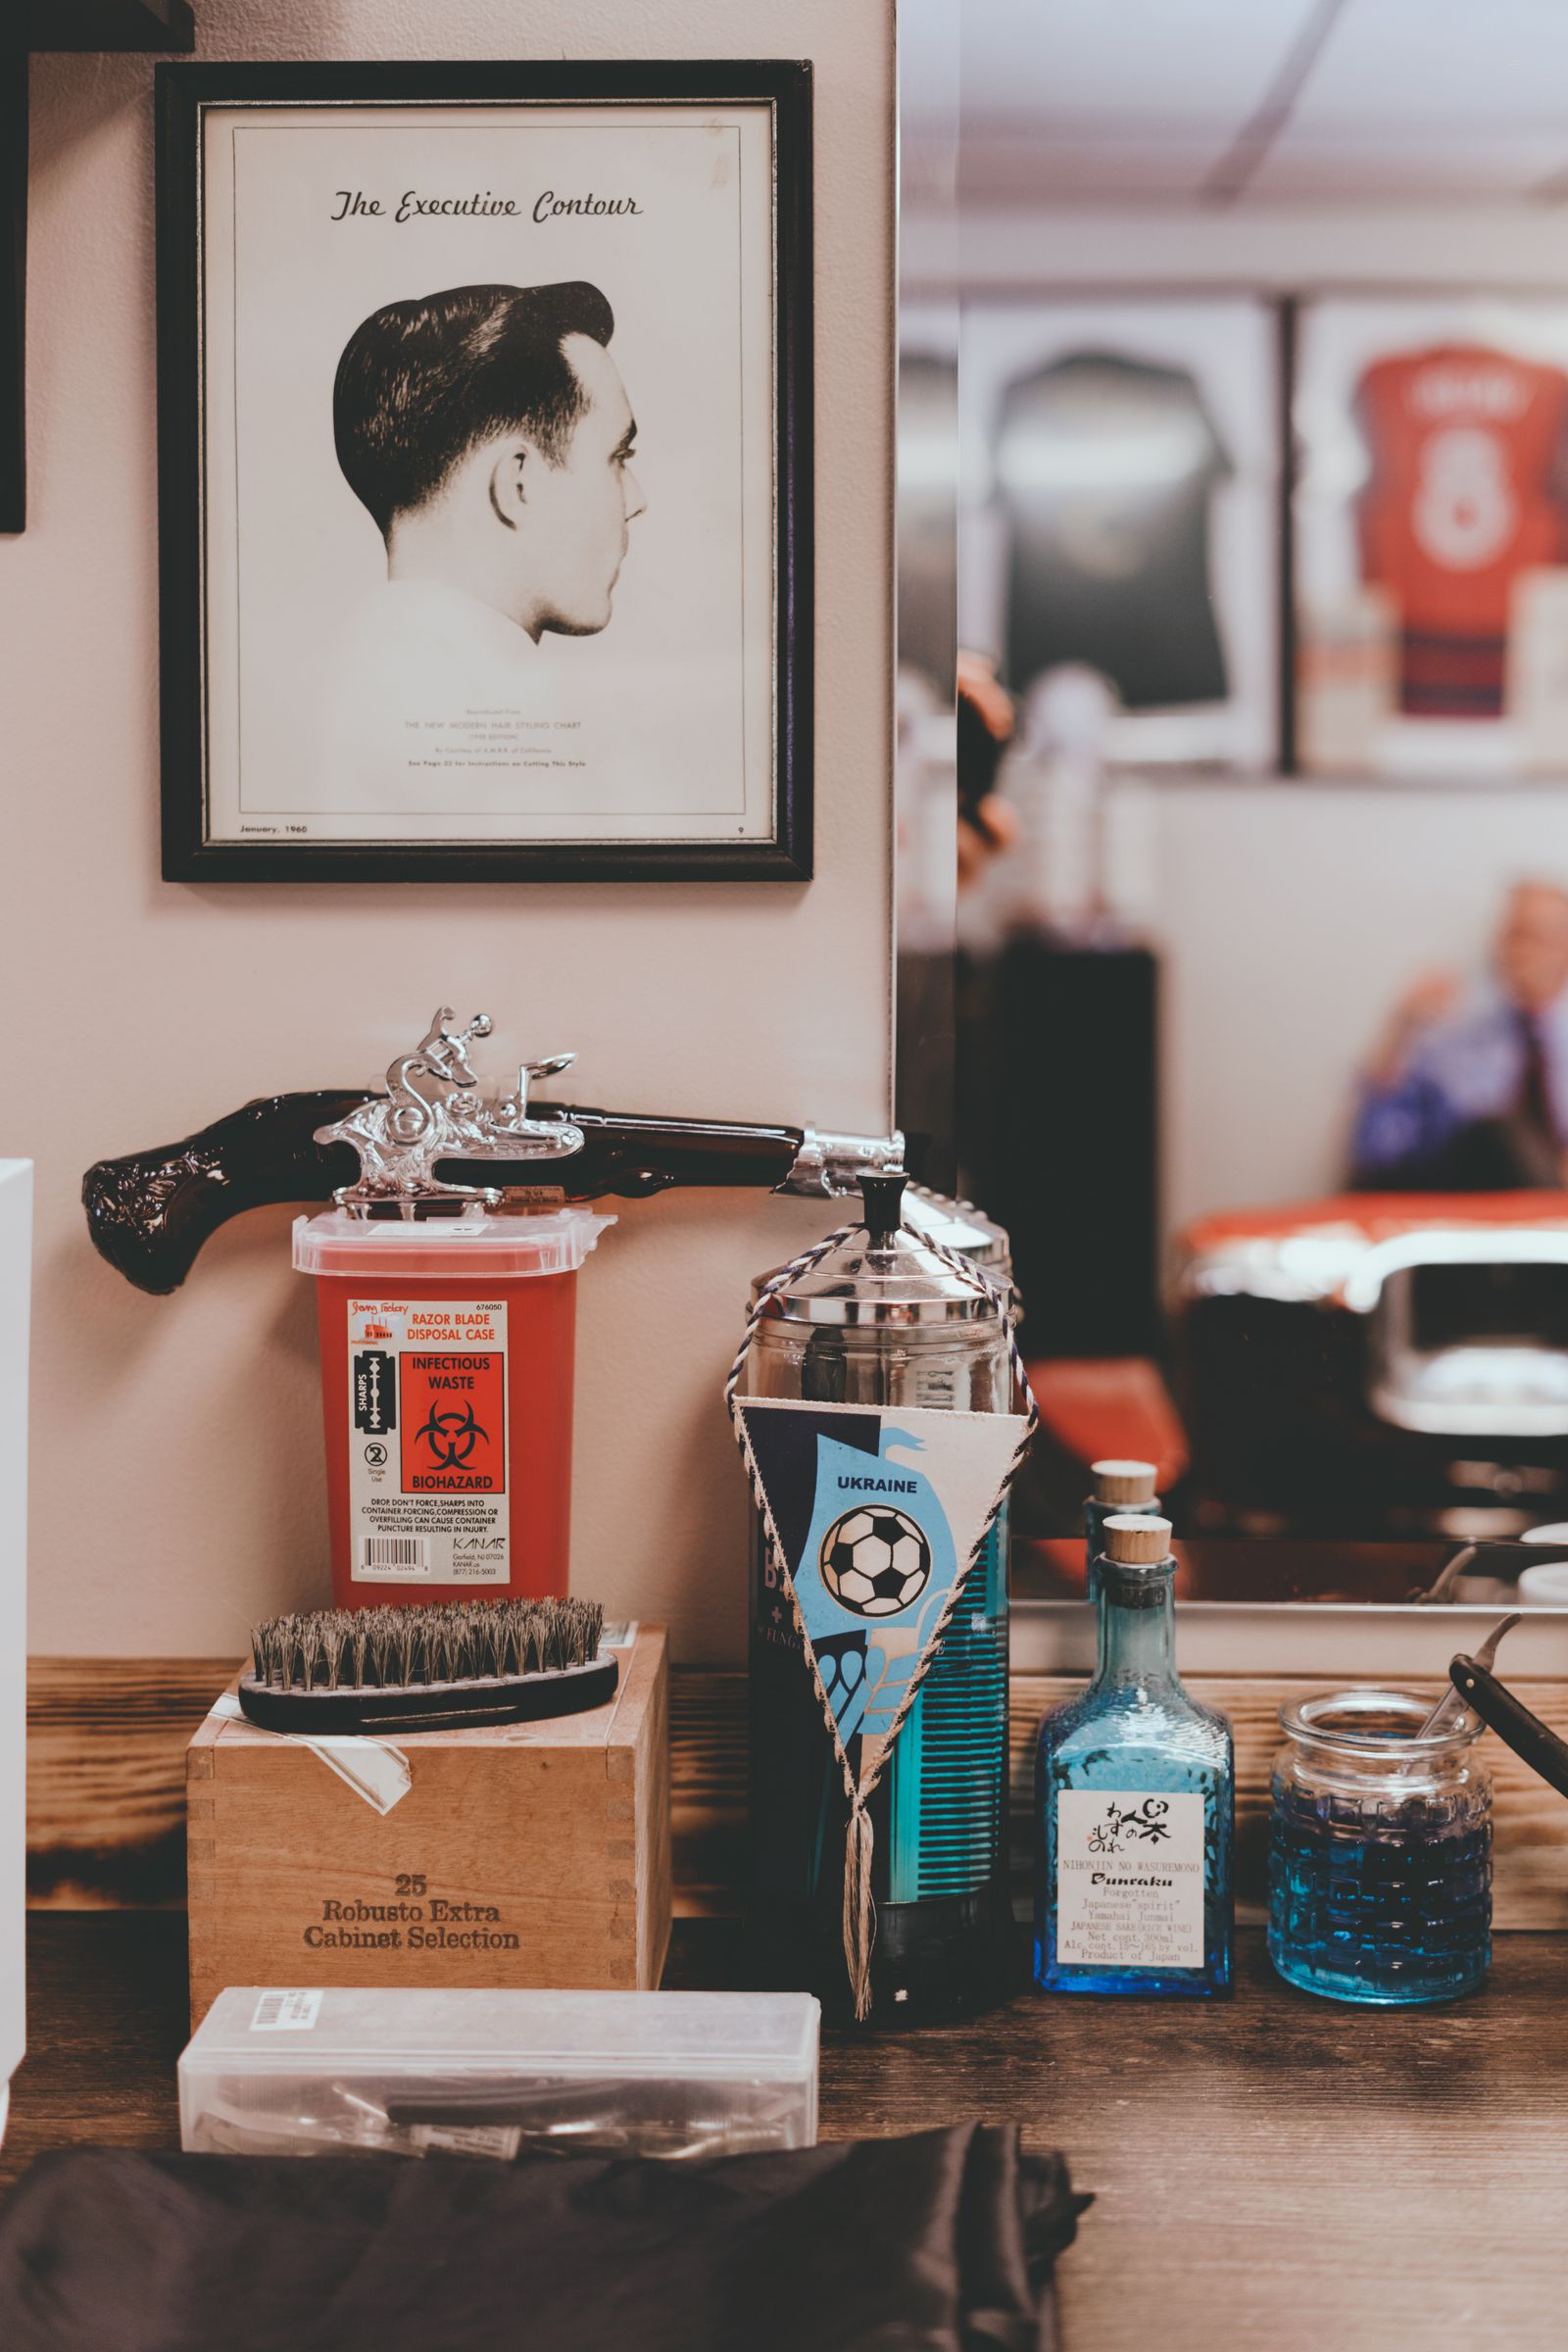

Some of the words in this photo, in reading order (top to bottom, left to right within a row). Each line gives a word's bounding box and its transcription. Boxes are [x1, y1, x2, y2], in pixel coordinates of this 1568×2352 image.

[331, 191, 386, 220] The
[394, 191, 522, 222] Executive
[532, 191, 644, 222] Contour
[412, 1313, 452, 1326] RAZOR
[455, 1313, 490, 1326] BLADE
[407, 1329, 462, 1342] DISPOSAL
[466, 1329, 495, 1342] CASE
[413, 1357, 490, 1371] INFECTIOUS
[428, 1376, 474, 1390] WASTE
[358, 1373, 368, 1412] SHARPS
[412, 1475, 494, 1490] BIOHAZARD
[837, 1476, 917, 1494] UKRAINE
[392, 1498, 415, 1507] DON'T
[466, 1498, 485, 1507] INTO
[487, 1507, 499, 1516] OR
[368, 1515, 413, 1524] OVERFILLING
[414, 1516, 430, 1525] CAN
[431, 1516, 454, 1525] CAUSE
[455, 1516, 496, 1525] CONTAINER
[377, 1525, 414, 1534] PUNCTURE
[415, 1525, 452, 1534] RESULTING
[453, 1525, 462, 1534] IN
[453, 1538, 506, 1549] KANAR
[1063, 1860, 1113, 1870] NIHONJIN
[1119, 1861, 1132, 1871] NO
[1137, 1862, 1200, 1873] WASUREMONO
[394, 1874, 427, 1897] 25
[1091, 1872, 1173, 1886] Bunraku
[1103, 1886, 1159, 1899] Forgotten
[1082, 1898, 1131, 1910] Japanese
[322, 1899, 423, 1923] Robusto
[427, 1899, 501, 1923] Extra
[1089, 1910, 1130, 1921] Yamahai
[1139, 1911, 1173, 1922] Junmai
[1070, 1921, 1112, 1931] JAPANESE
[304, 1926, 403, 1949] Cabinet
[407, 1926, 520, 1949] Selection
[1088, 1931, 1105, 1941] Net
[1081, 1947, 1125, 1959] Product
[1130, 1949, 1142, 1960] of
[1150, 1950, 1181, 1962] Japan
